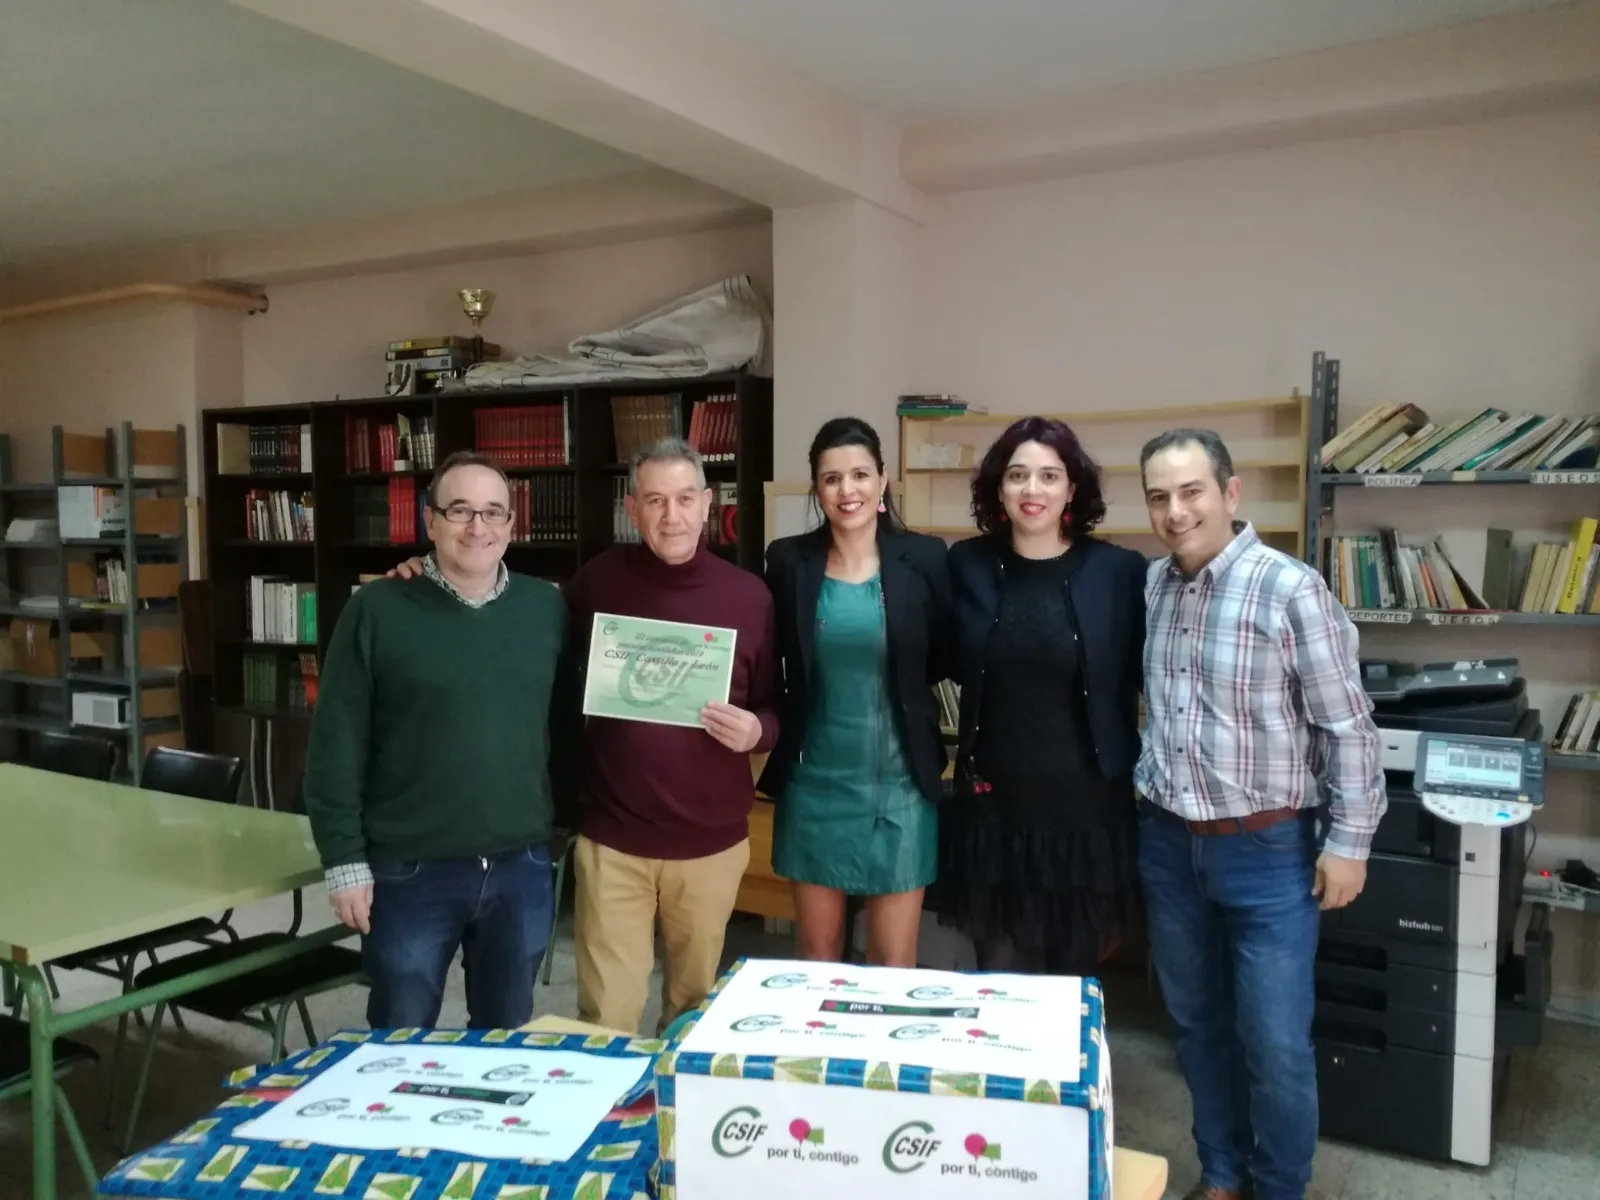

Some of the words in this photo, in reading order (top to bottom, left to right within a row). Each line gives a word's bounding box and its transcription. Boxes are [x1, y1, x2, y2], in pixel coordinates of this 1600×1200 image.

[1350, 611, 1409, 622] DEPORTES
[1431, 614, 1496, 624] JUEGOS
[604, 649, 630, 660] CSIF
[636, 653, 679, 666] Castilla
[1399, 918, 1430, 931] bizhub
[723, 1121, 769, 1143] CSIF
[767, 1147, 790, 1160] por
[793, 1146, 805, 1162] ti,
[809, 1150, 860, 1166] contigo
[894, 1136, 942, 1158] CSIF
[941, 1163, 964, 1175] por
[968, 1163, 981, 1178] ti,
[985, 1166, 1038, 1183] contigo
